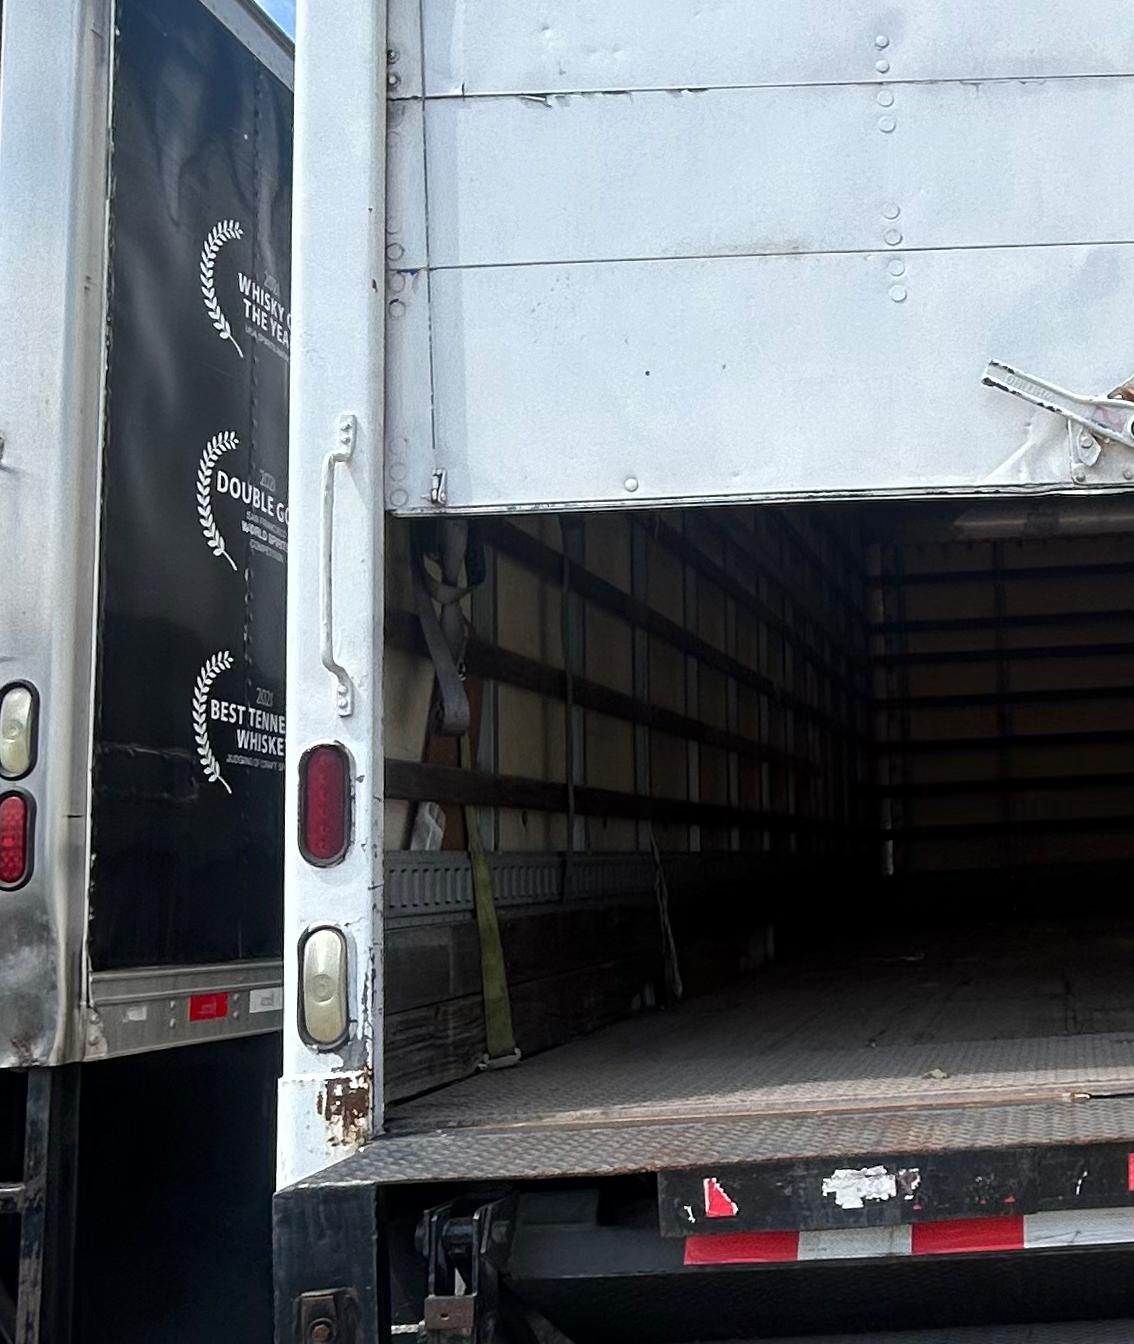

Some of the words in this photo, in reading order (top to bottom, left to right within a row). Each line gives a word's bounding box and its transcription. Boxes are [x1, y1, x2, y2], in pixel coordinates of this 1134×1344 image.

[238, 272, 285, 323] WHISKY
[243, 298, 268, 331] THE
[217, 470, 275, 516] DOUBLE
[210, 699, 246, 725] BEST
[248, 707, 286, 734] TENNE
